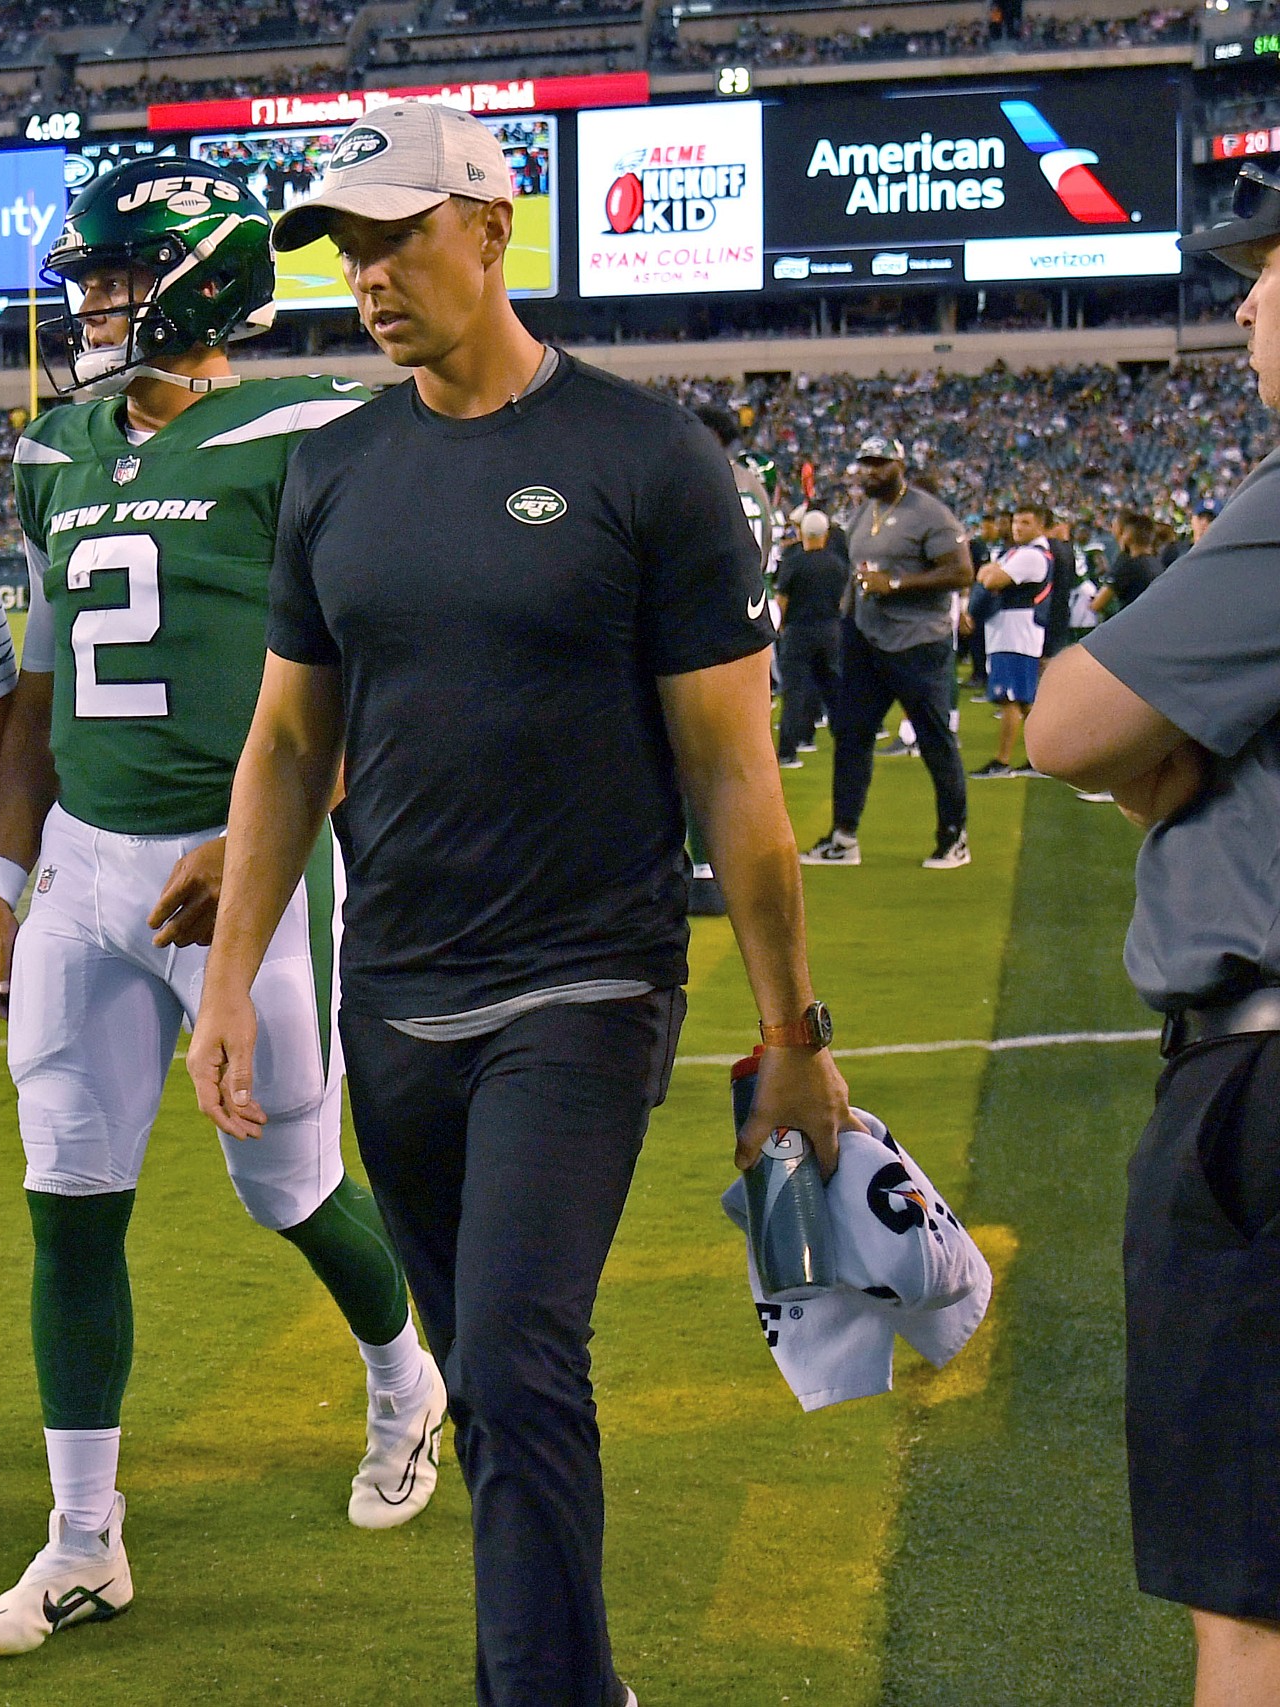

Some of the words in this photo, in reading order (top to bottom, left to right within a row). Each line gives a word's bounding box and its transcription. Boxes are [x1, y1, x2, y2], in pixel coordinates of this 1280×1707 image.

[276, 94, 364, 124] Lincoln
[473, 80, 535, 111] Field
[26, 112, 80, 141] 4:02
[649, 145, 706, 165] ACME
[806, 132, 1005, 177] American
[117, 176, 240, 212] JETS
[642, 164, 745, 201] KICKOFF
[845, 172, 1005, 215] Airlines
[643, 199, 716, 233] KID
[590, 250, 648, 268] RYAN
[657, 246, 754, 266] COLLINS
[1030, 251, 1106, 268] verizon
[50, 504, 110, 536] NEW
[113, 500, 217, 522] YORK
[513, 500, 559, 512] JETS
[67, 533, 169, 718] 2
